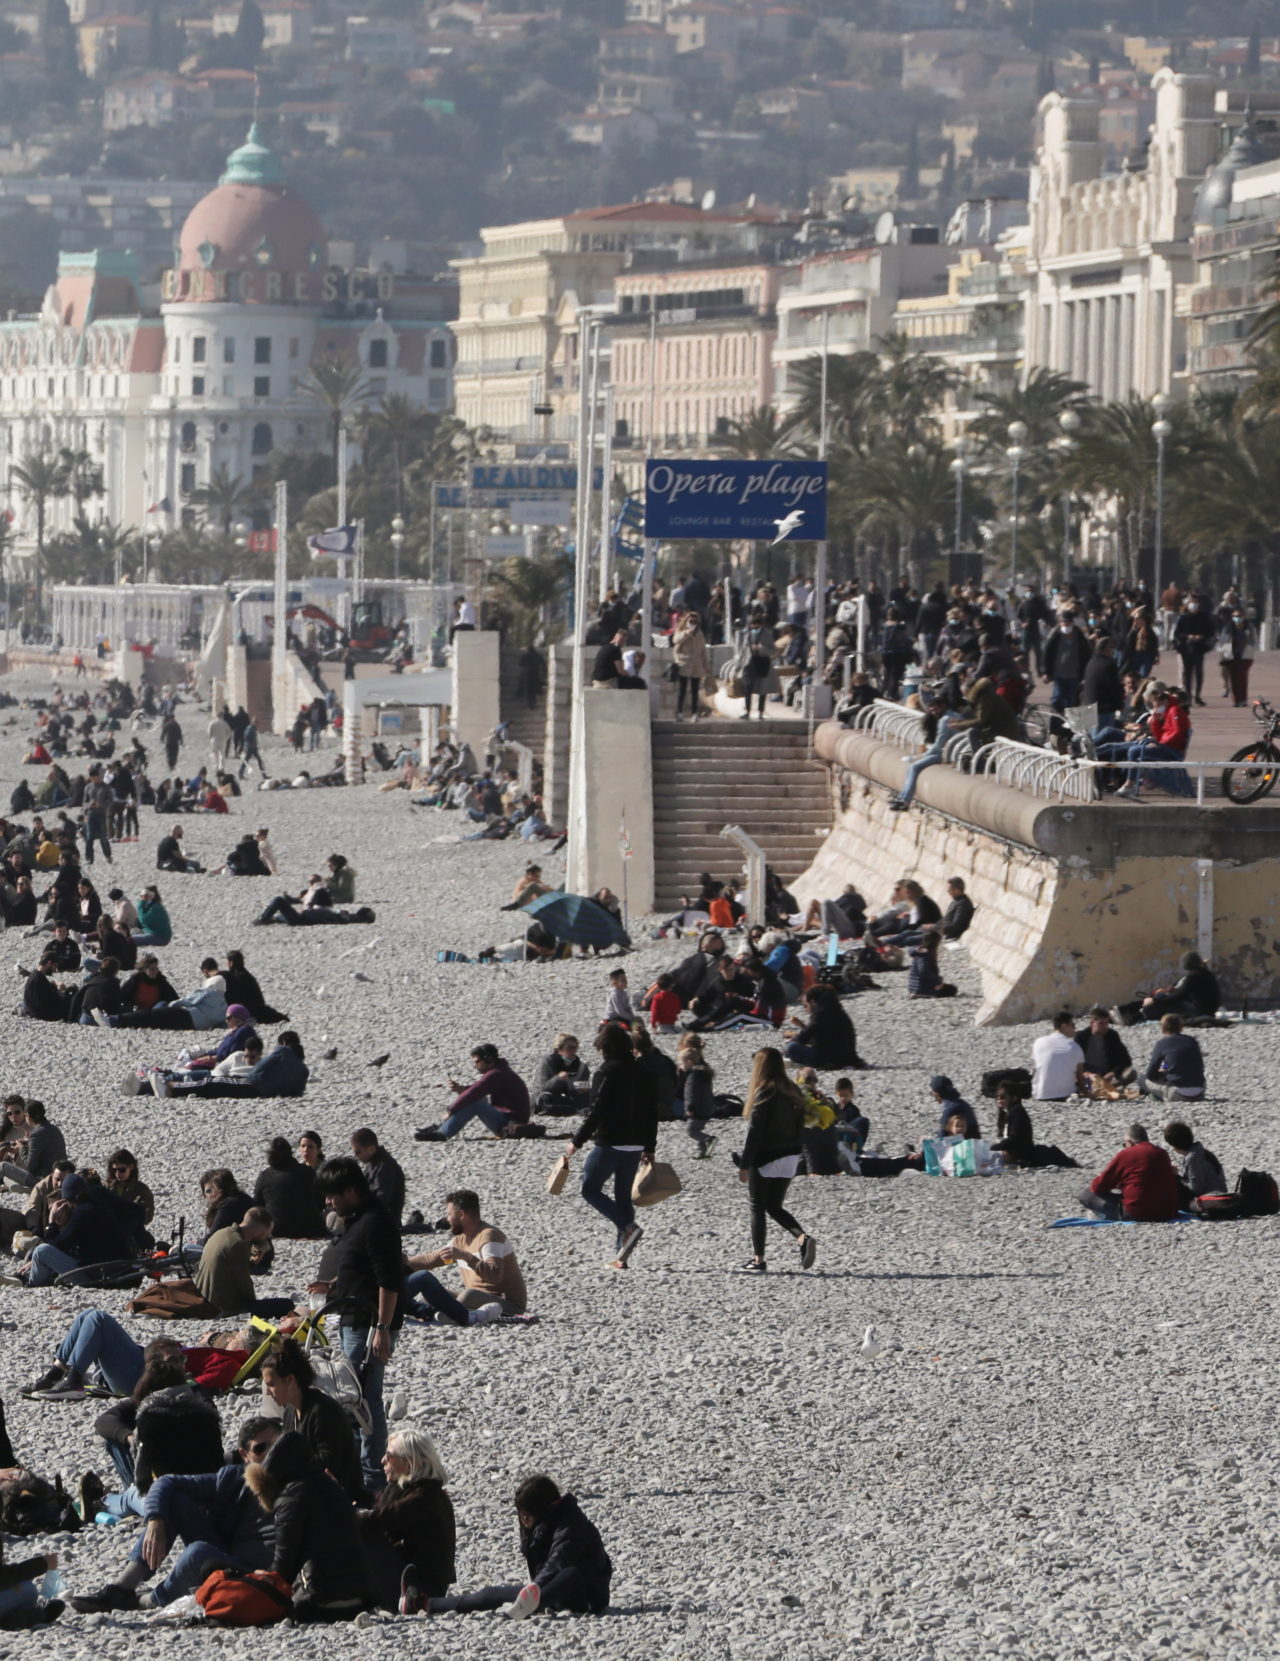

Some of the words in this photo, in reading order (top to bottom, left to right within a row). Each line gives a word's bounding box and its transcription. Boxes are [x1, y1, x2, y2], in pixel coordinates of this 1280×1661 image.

[473, 466, 531, 488] BEAU
[647, 465, 738, 505] Opera
[738, 462, 825, 508] plage
[669, 516, 709, 526] LOUNGE
[711, 516, 732, 526] BAR
